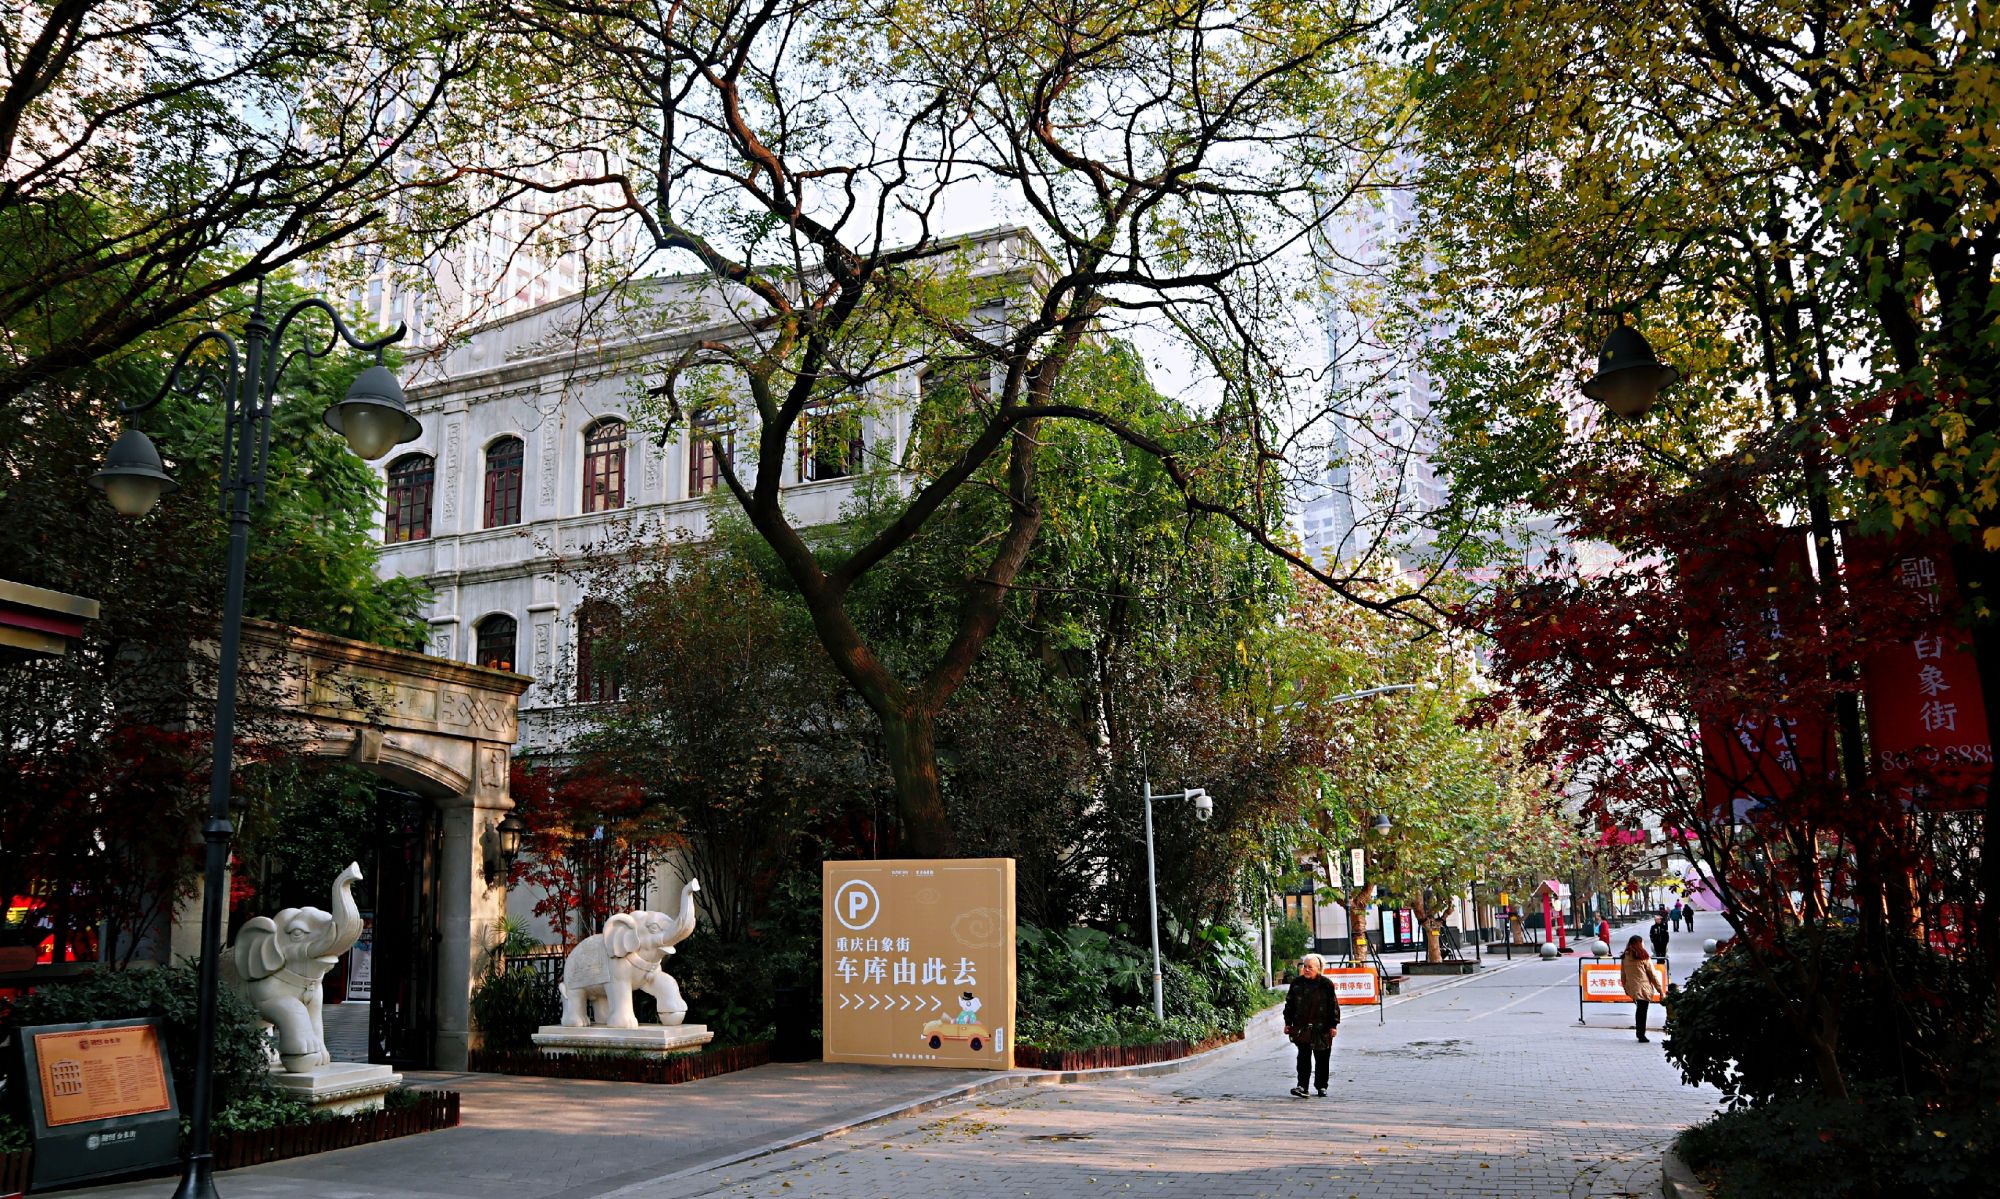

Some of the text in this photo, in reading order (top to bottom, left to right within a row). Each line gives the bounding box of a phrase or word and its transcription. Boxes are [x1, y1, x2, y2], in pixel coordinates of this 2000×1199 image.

[849, 891, 868, 919] P
[835, 937, 910, 953] 重庆白象街
[835, 956, 977, 986] 车库由此去
